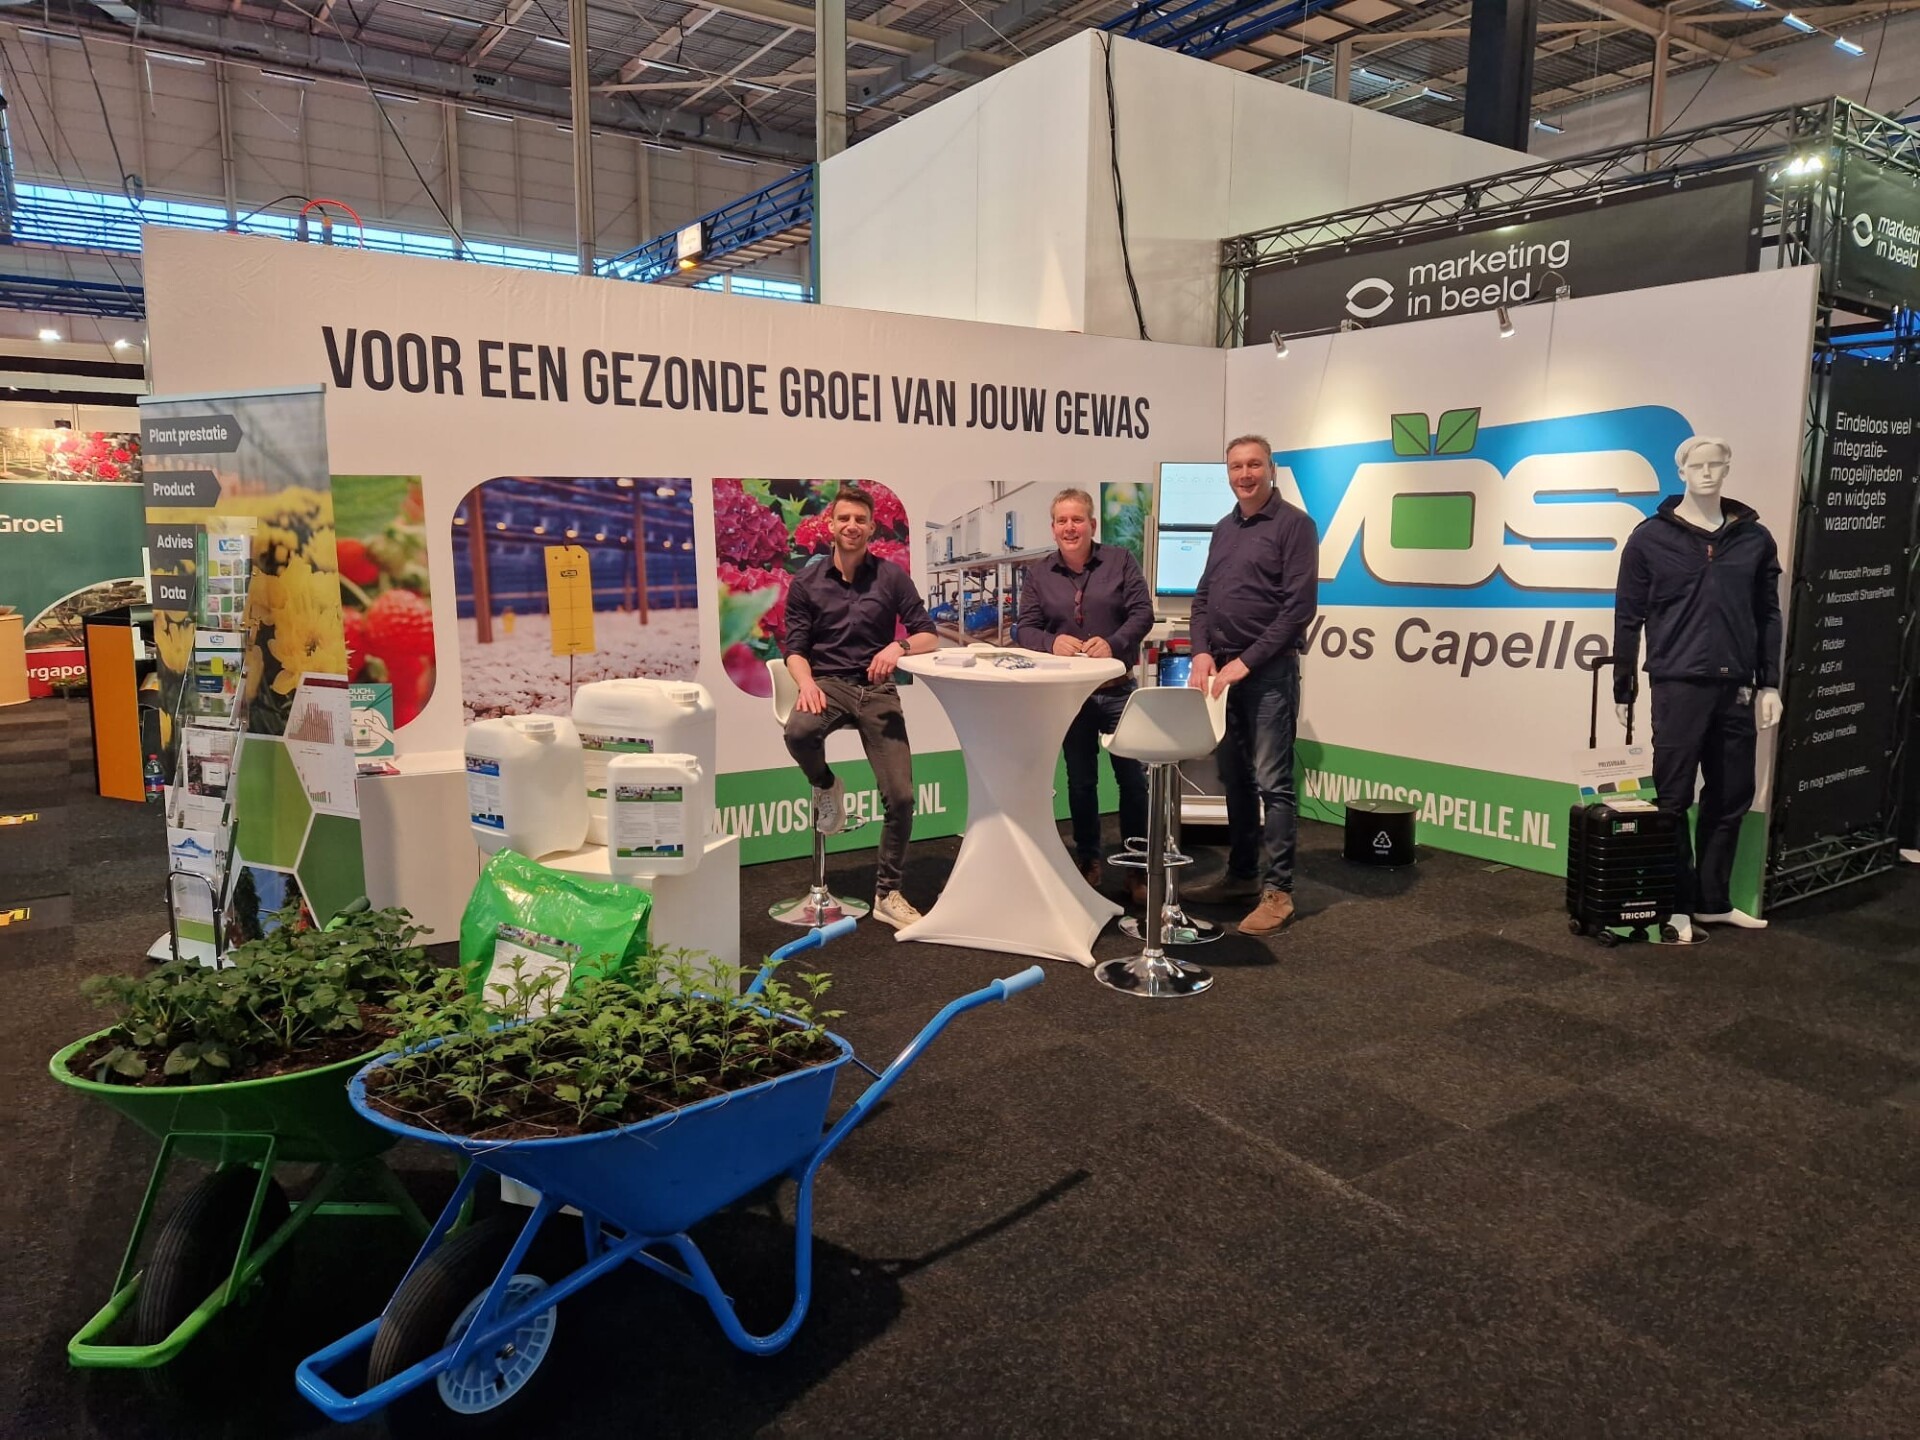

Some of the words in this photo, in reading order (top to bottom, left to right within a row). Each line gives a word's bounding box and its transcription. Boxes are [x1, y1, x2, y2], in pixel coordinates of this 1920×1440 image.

[1878, 216, 1920, 246] marketi
[1877, 235, 1887, 257] in
[1888, 240, 1919, 269] beeld
[1408, 239, 1571, 287] marketing
[1407, 291, 1431, 316] in
[1441, 272, 1531, 312] beeld
[321, 326, 464, 396] VOOR
[478, 339, 568, 402] EEN
[582, 348, 768, 416] GEZONDE
[779, 366, 881, 423] GROEI
[891, 375, 956, 428] VAN
[966, 382, 1047, 433] JOUW
[1055, 390, 1151, 440] GEWAS
[1836, 411, 1888, 434] Eindeloos
[1891, 417, 1912, 435] veel
[149, 428, 177, 443] Plant
[179, 424, 228, 447] prestatie
[1833, 437, 1888, 461] integratie-
[153, 481, 196, 496] Product
[1827, 491, 1842, 506] en
[1845, 488, 1887, 510] widgets
[0, 514, 64, 533] Groei
[1825, 512, 1886, 531] waaronder:
[156, 533, 194, 549] Advies
[1829, 567, 1861, 580] Microsoft
[1862, 566, 1883, 577] Power
[160, 585, 187, 600] Data
[1826, 590, 1859, 604] Microsoft
[1860, 587, 1895, 600] SharePoint
[1394, 617, 1609, 678] Capelle
[1822, 638, 1846, 651] Ridder
[26, 665, 87, 681] rgapo
[348, 687, 371, 695] OUCH
[348, 694, 377, 702] OLLECT
[1817, 682, 1856, 697] Freshplaza
[1815, 702, 1865, 720] Goedemorgen
[1812, 729, 1834, 743] Social
[1835, 723, 1857, 738] media
[1798, 780, 1808, 792] En
[1810, 777, 1824, 788] nog
[711, 782, 947, 838] WW.VOSPEL.NL
[1305, 767, 1556, 850] WWWVOSCAPELLE.NL
[1620, 911, 1656, 920] TRICORP
